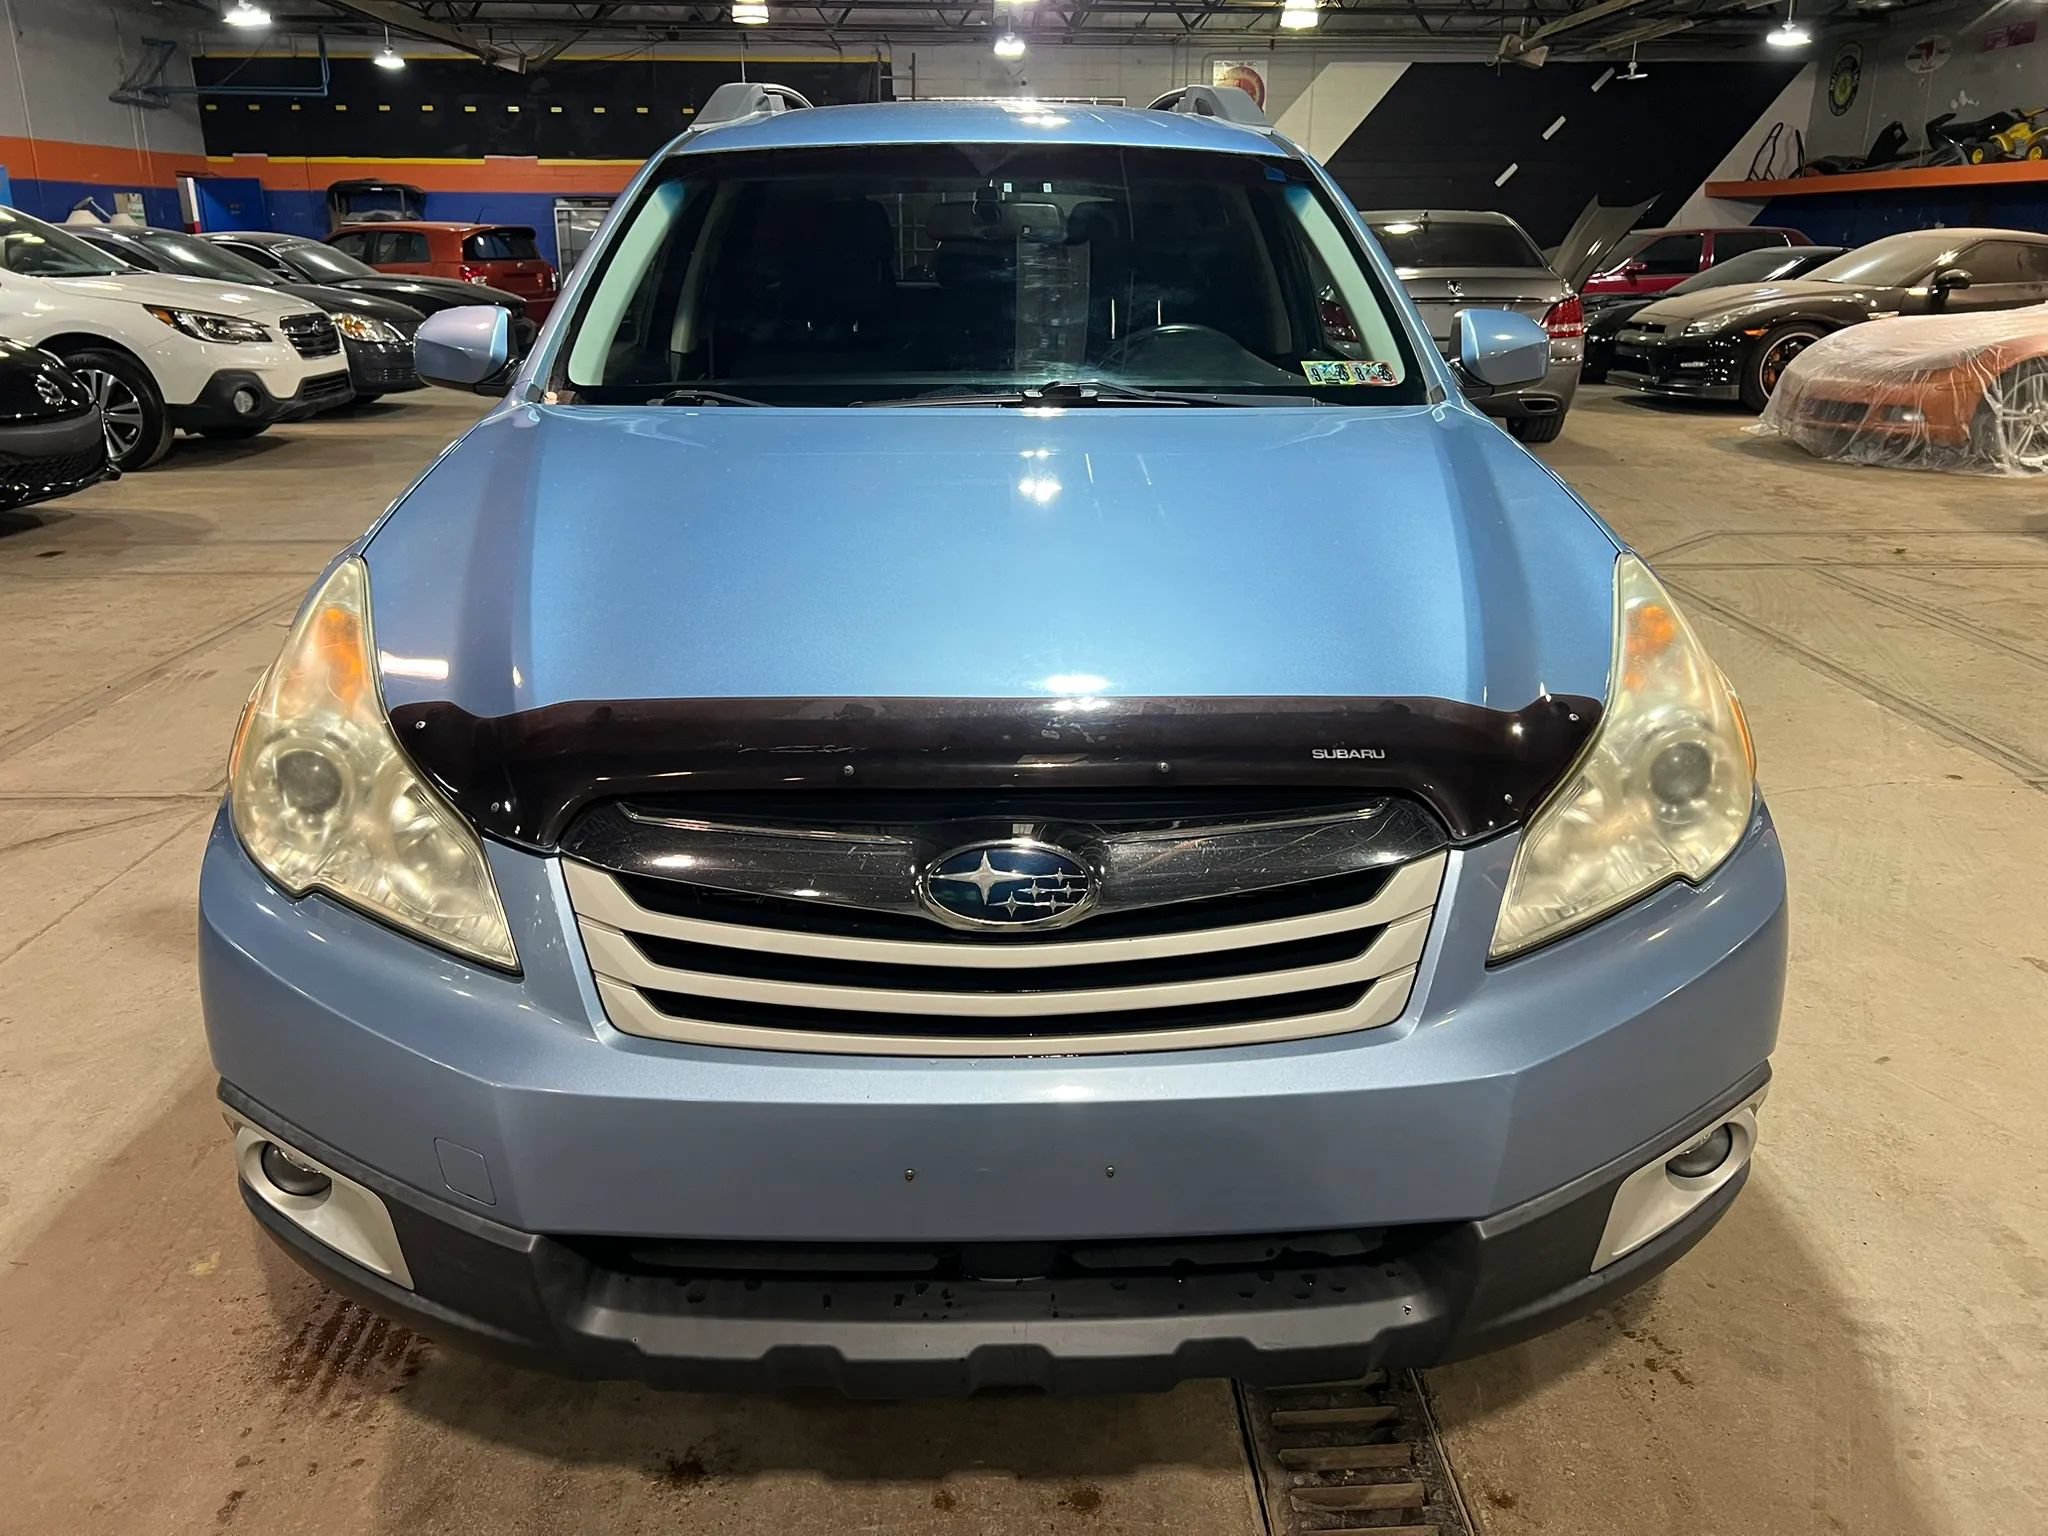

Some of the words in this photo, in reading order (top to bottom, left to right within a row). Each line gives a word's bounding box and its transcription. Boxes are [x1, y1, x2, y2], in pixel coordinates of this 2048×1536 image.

[1311, 368, 1322, 382] 9
[1354, 367, 1366, 381] 8
[1312, 749, 1386, 759] SUBARU
